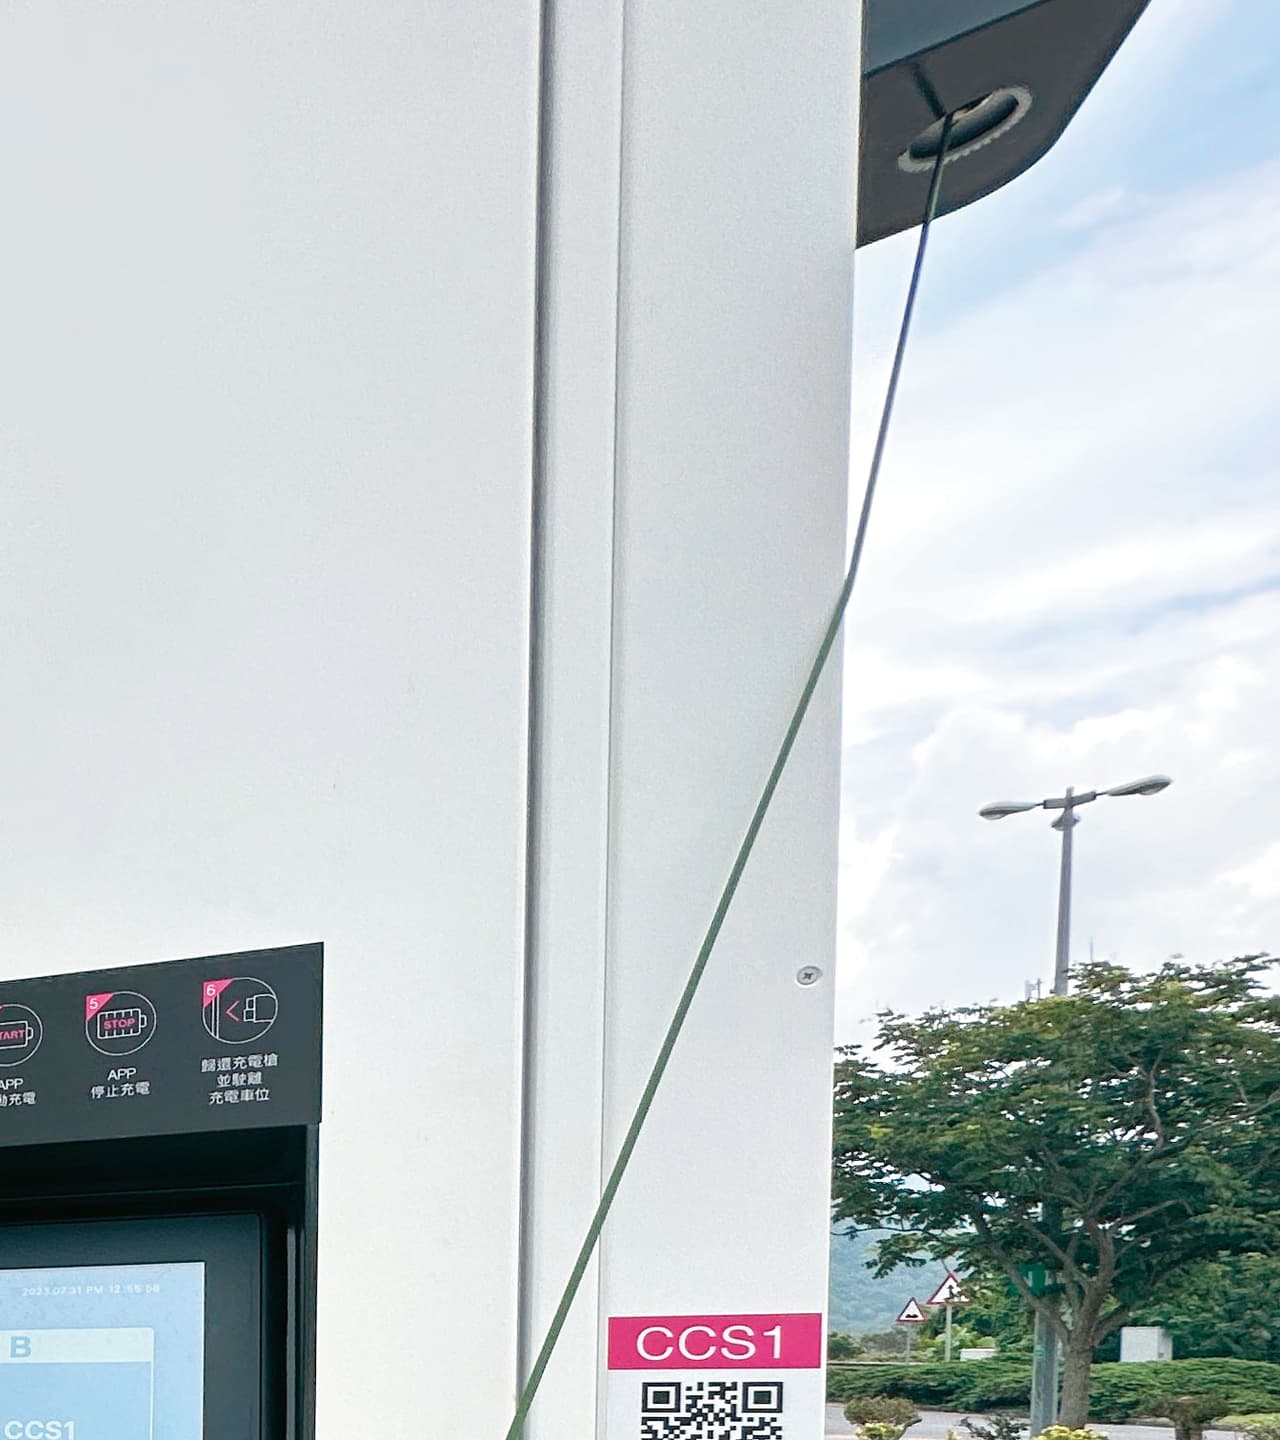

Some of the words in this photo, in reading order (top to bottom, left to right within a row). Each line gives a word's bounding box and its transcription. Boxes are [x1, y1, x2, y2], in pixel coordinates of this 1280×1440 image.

[206, 985, 216, 996] 6
[89, 998, 99, 1010] 5
[103, 1018, 136, 1030] STOP
[201, 1053, 278, 1073] 歸還充電槍
[107, 1068, 137, 1081] APP
[90, 1081, 151, 1100] 停止充電
[208, 1087, 270, 1105] 充電車位
[9, 1335, 31, 1358] B
[636, 1325, 783, 1361] CCS1
[4, 1419, 75, 1440] CCS1
